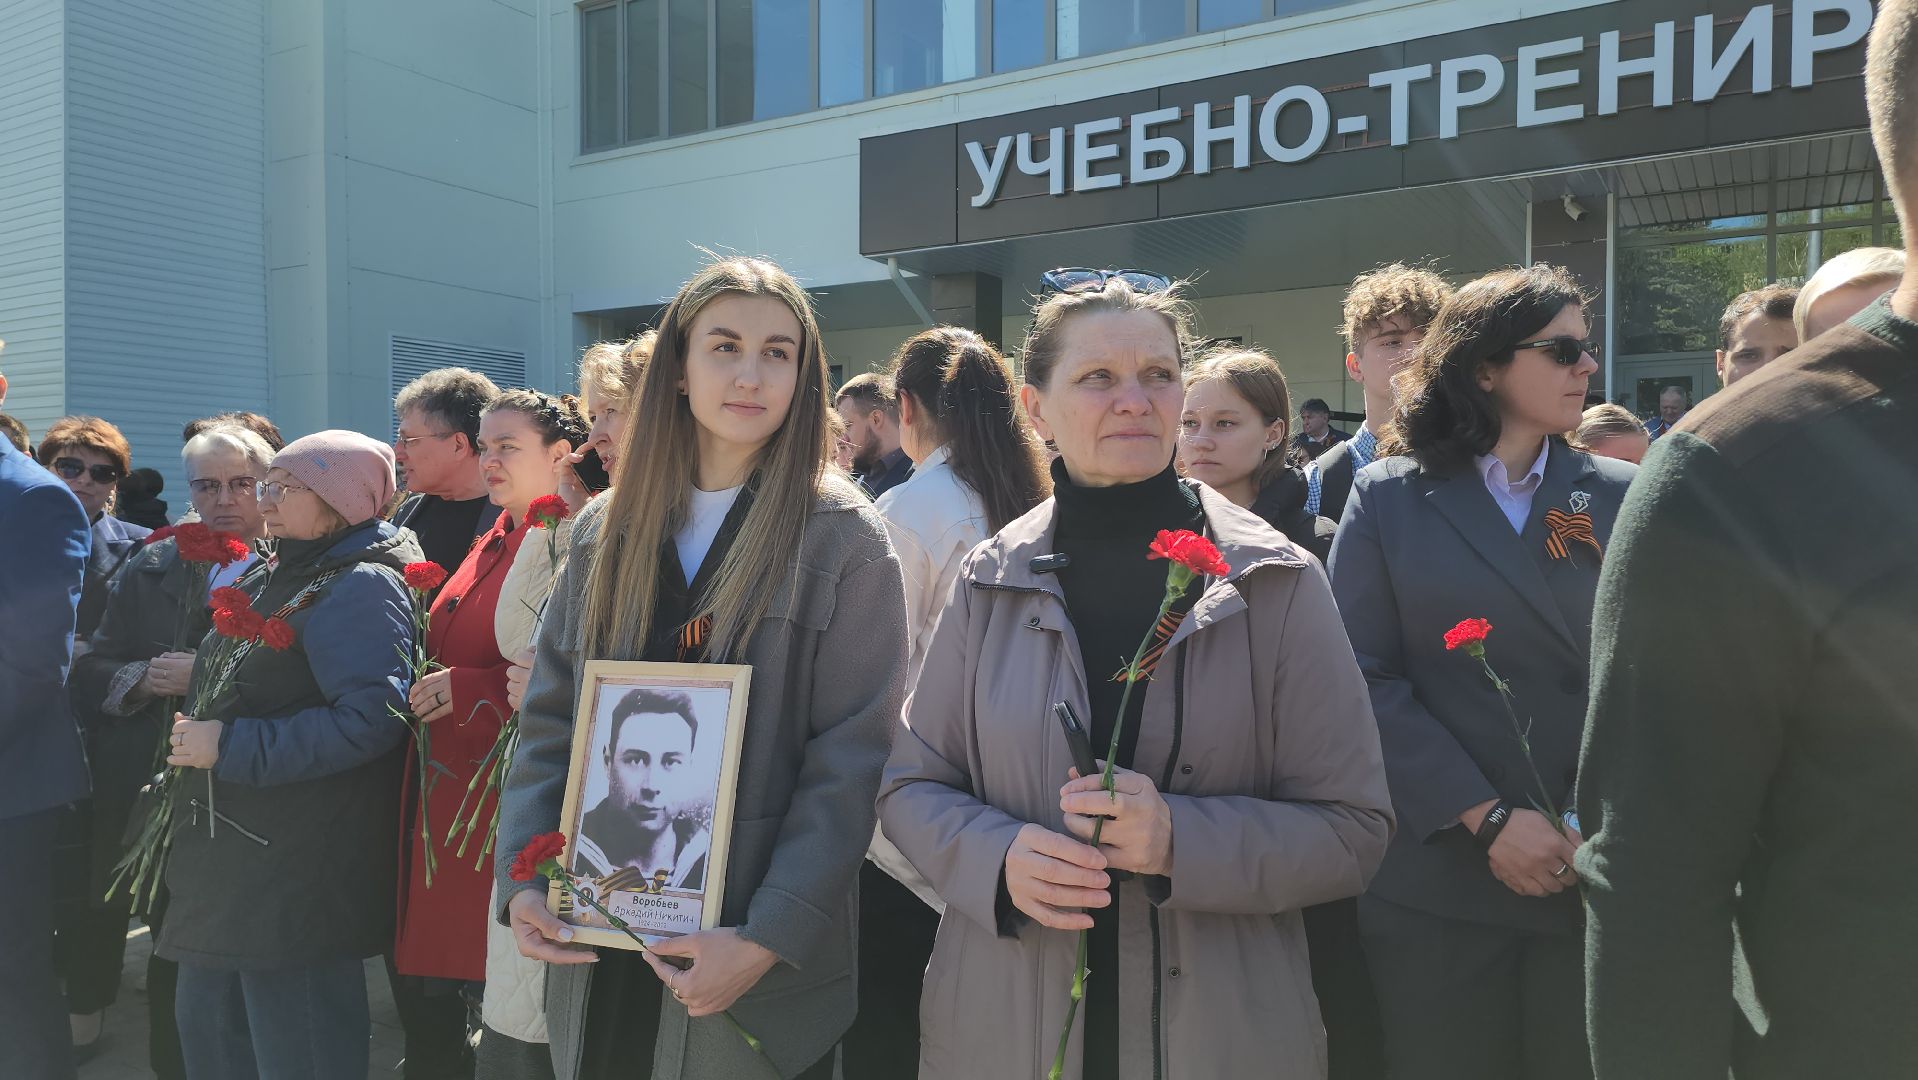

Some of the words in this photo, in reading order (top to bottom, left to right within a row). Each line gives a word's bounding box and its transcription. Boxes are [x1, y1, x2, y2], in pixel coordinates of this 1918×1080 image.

[632, 895, 679, 909] Воробьев
[613, 905, 653, 919] Аркадий
[655, 910, 694, 924] Никитич
